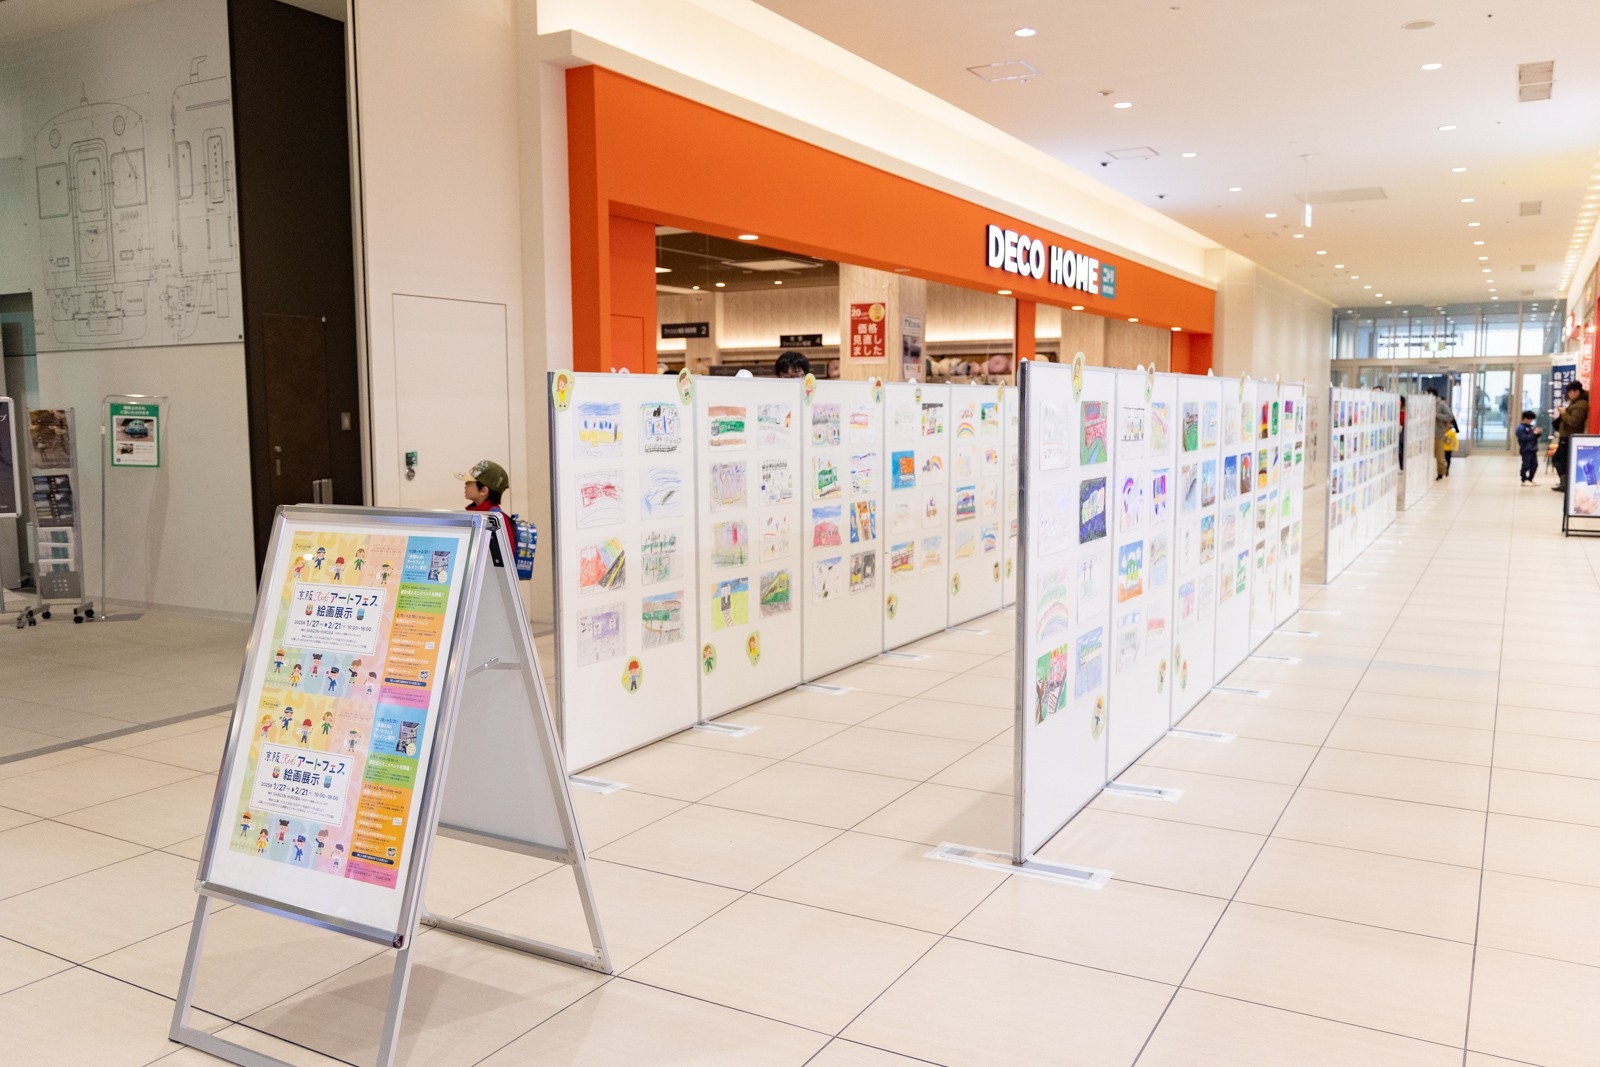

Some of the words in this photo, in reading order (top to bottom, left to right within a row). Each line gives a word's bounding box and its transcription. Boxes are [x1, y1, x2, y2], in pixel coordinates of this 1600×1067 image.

[987, 224, 1045, 279] DECO
[1049, 245, 1099, 294] HOME
[701, 326, 707, 335] 2
[857, 323, 878, 334] 価格
[853, 334, 882, 346] 見直し
[853, 346, 882, 356] ました
[316, 604, 353, 619] 絵画展示
[306, 619, 320, 628] 1/27
[327, 621, 342, 630] 2/21
[283, 768, 320, 786] 絵画展示
[273, 782, 287, 792] 1/27
[294, 786, 309, 796] 2/21
